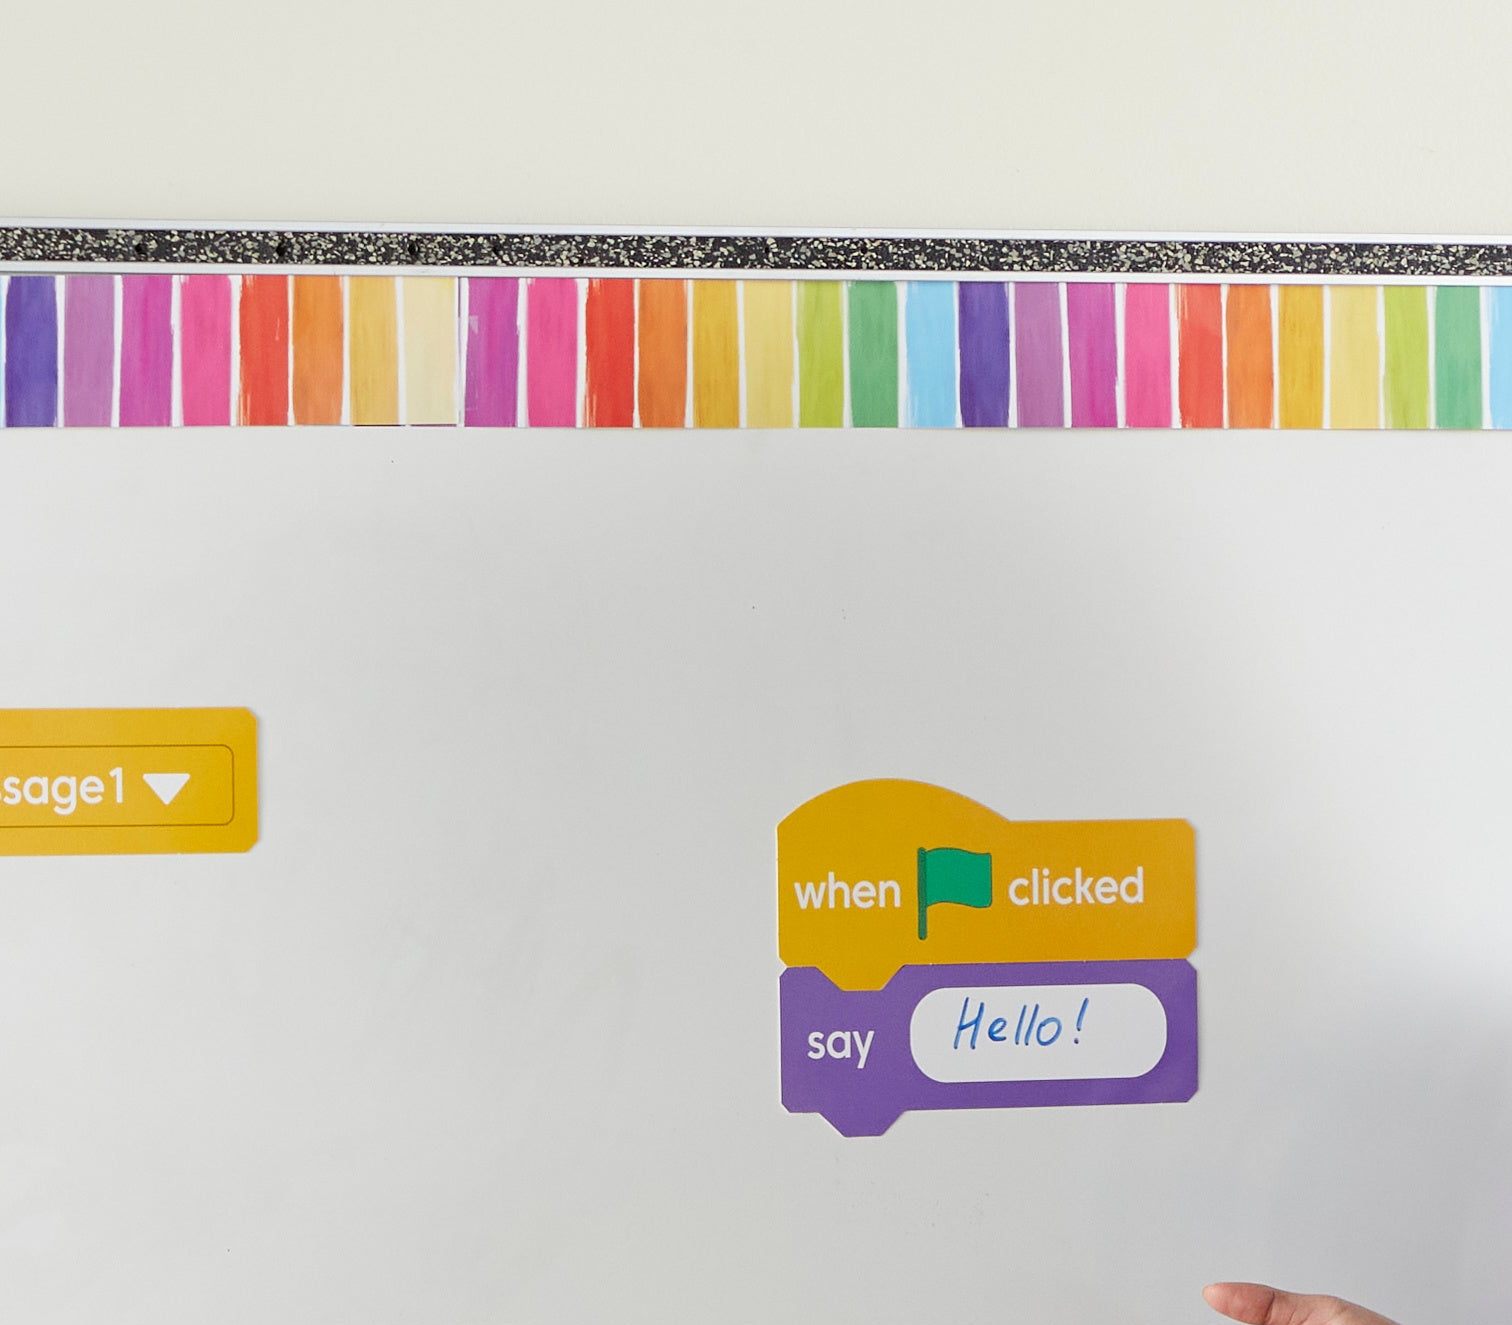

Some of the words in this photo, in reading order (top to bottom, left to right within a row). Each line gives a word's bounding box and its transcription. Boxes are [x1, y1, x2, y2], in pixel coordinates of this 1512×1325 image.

[793, 871, 901, 910] when
[1008, 866, 1145, 907] clicked
[807, 1030, 875, 1069] say
[953, 997, 1089, 1050] Hello!
